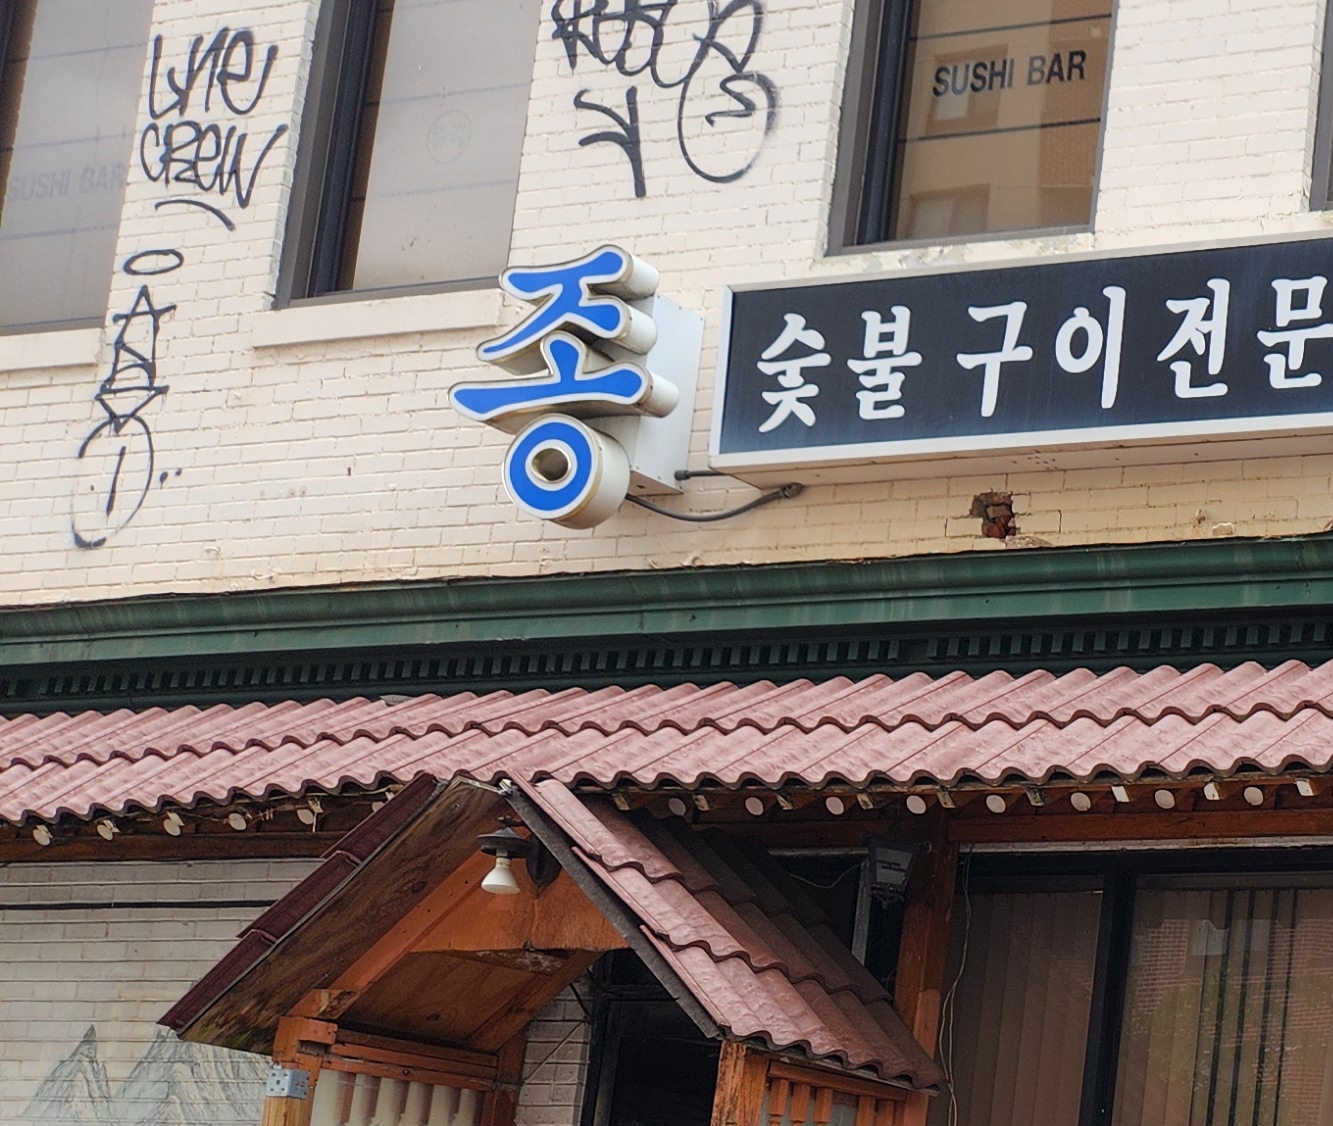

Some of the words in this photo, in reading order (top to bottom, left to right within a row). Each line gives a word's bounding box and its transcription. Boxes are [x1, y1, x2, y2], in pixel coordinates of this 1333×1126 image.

[932, 57, 1014, 98] SUSHI
[1027, 50, 1088, 87] BAR
[449, 246, 652, 523] 종
